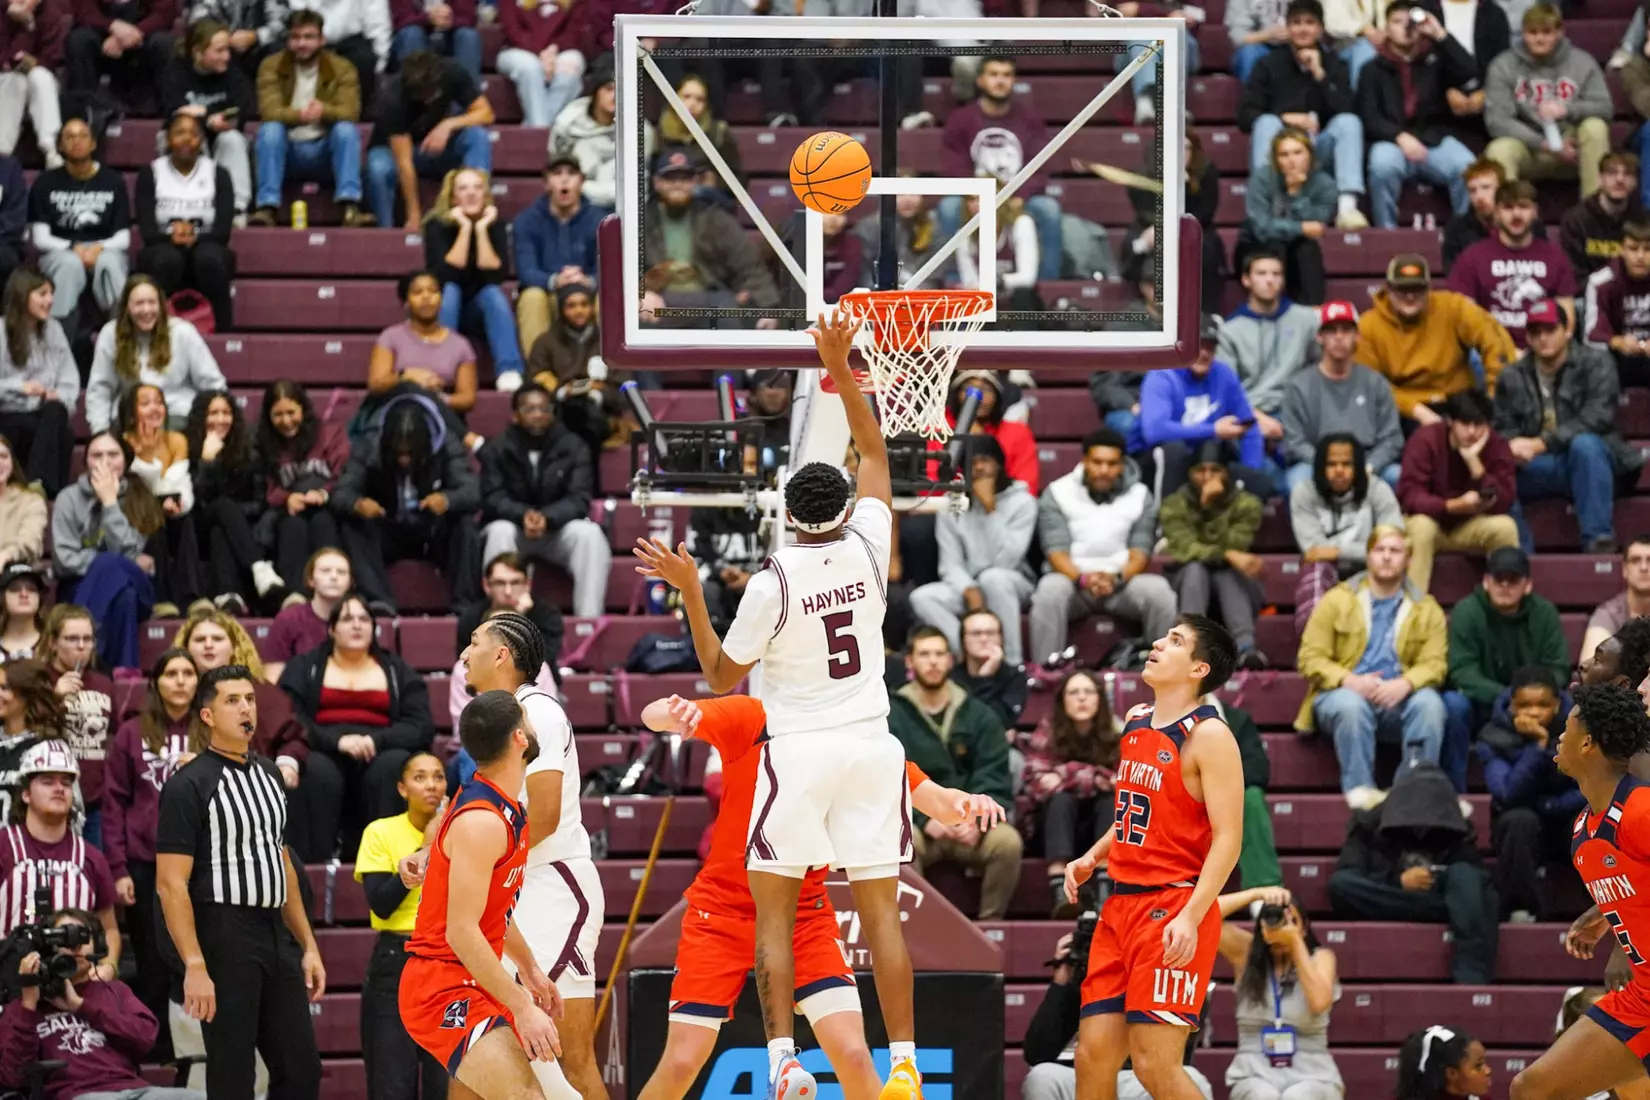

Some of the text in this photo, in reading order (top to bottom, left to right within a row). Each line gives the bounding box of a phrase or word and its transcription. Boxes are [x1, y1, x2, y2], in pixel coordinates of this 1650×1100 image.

[1491, 259, 1547, 278] DAWG
[801, 581, 866, 615] HAYNES
[820, 609, 862, 680] 5
[1153, 967, 1199, 1006] UTM
